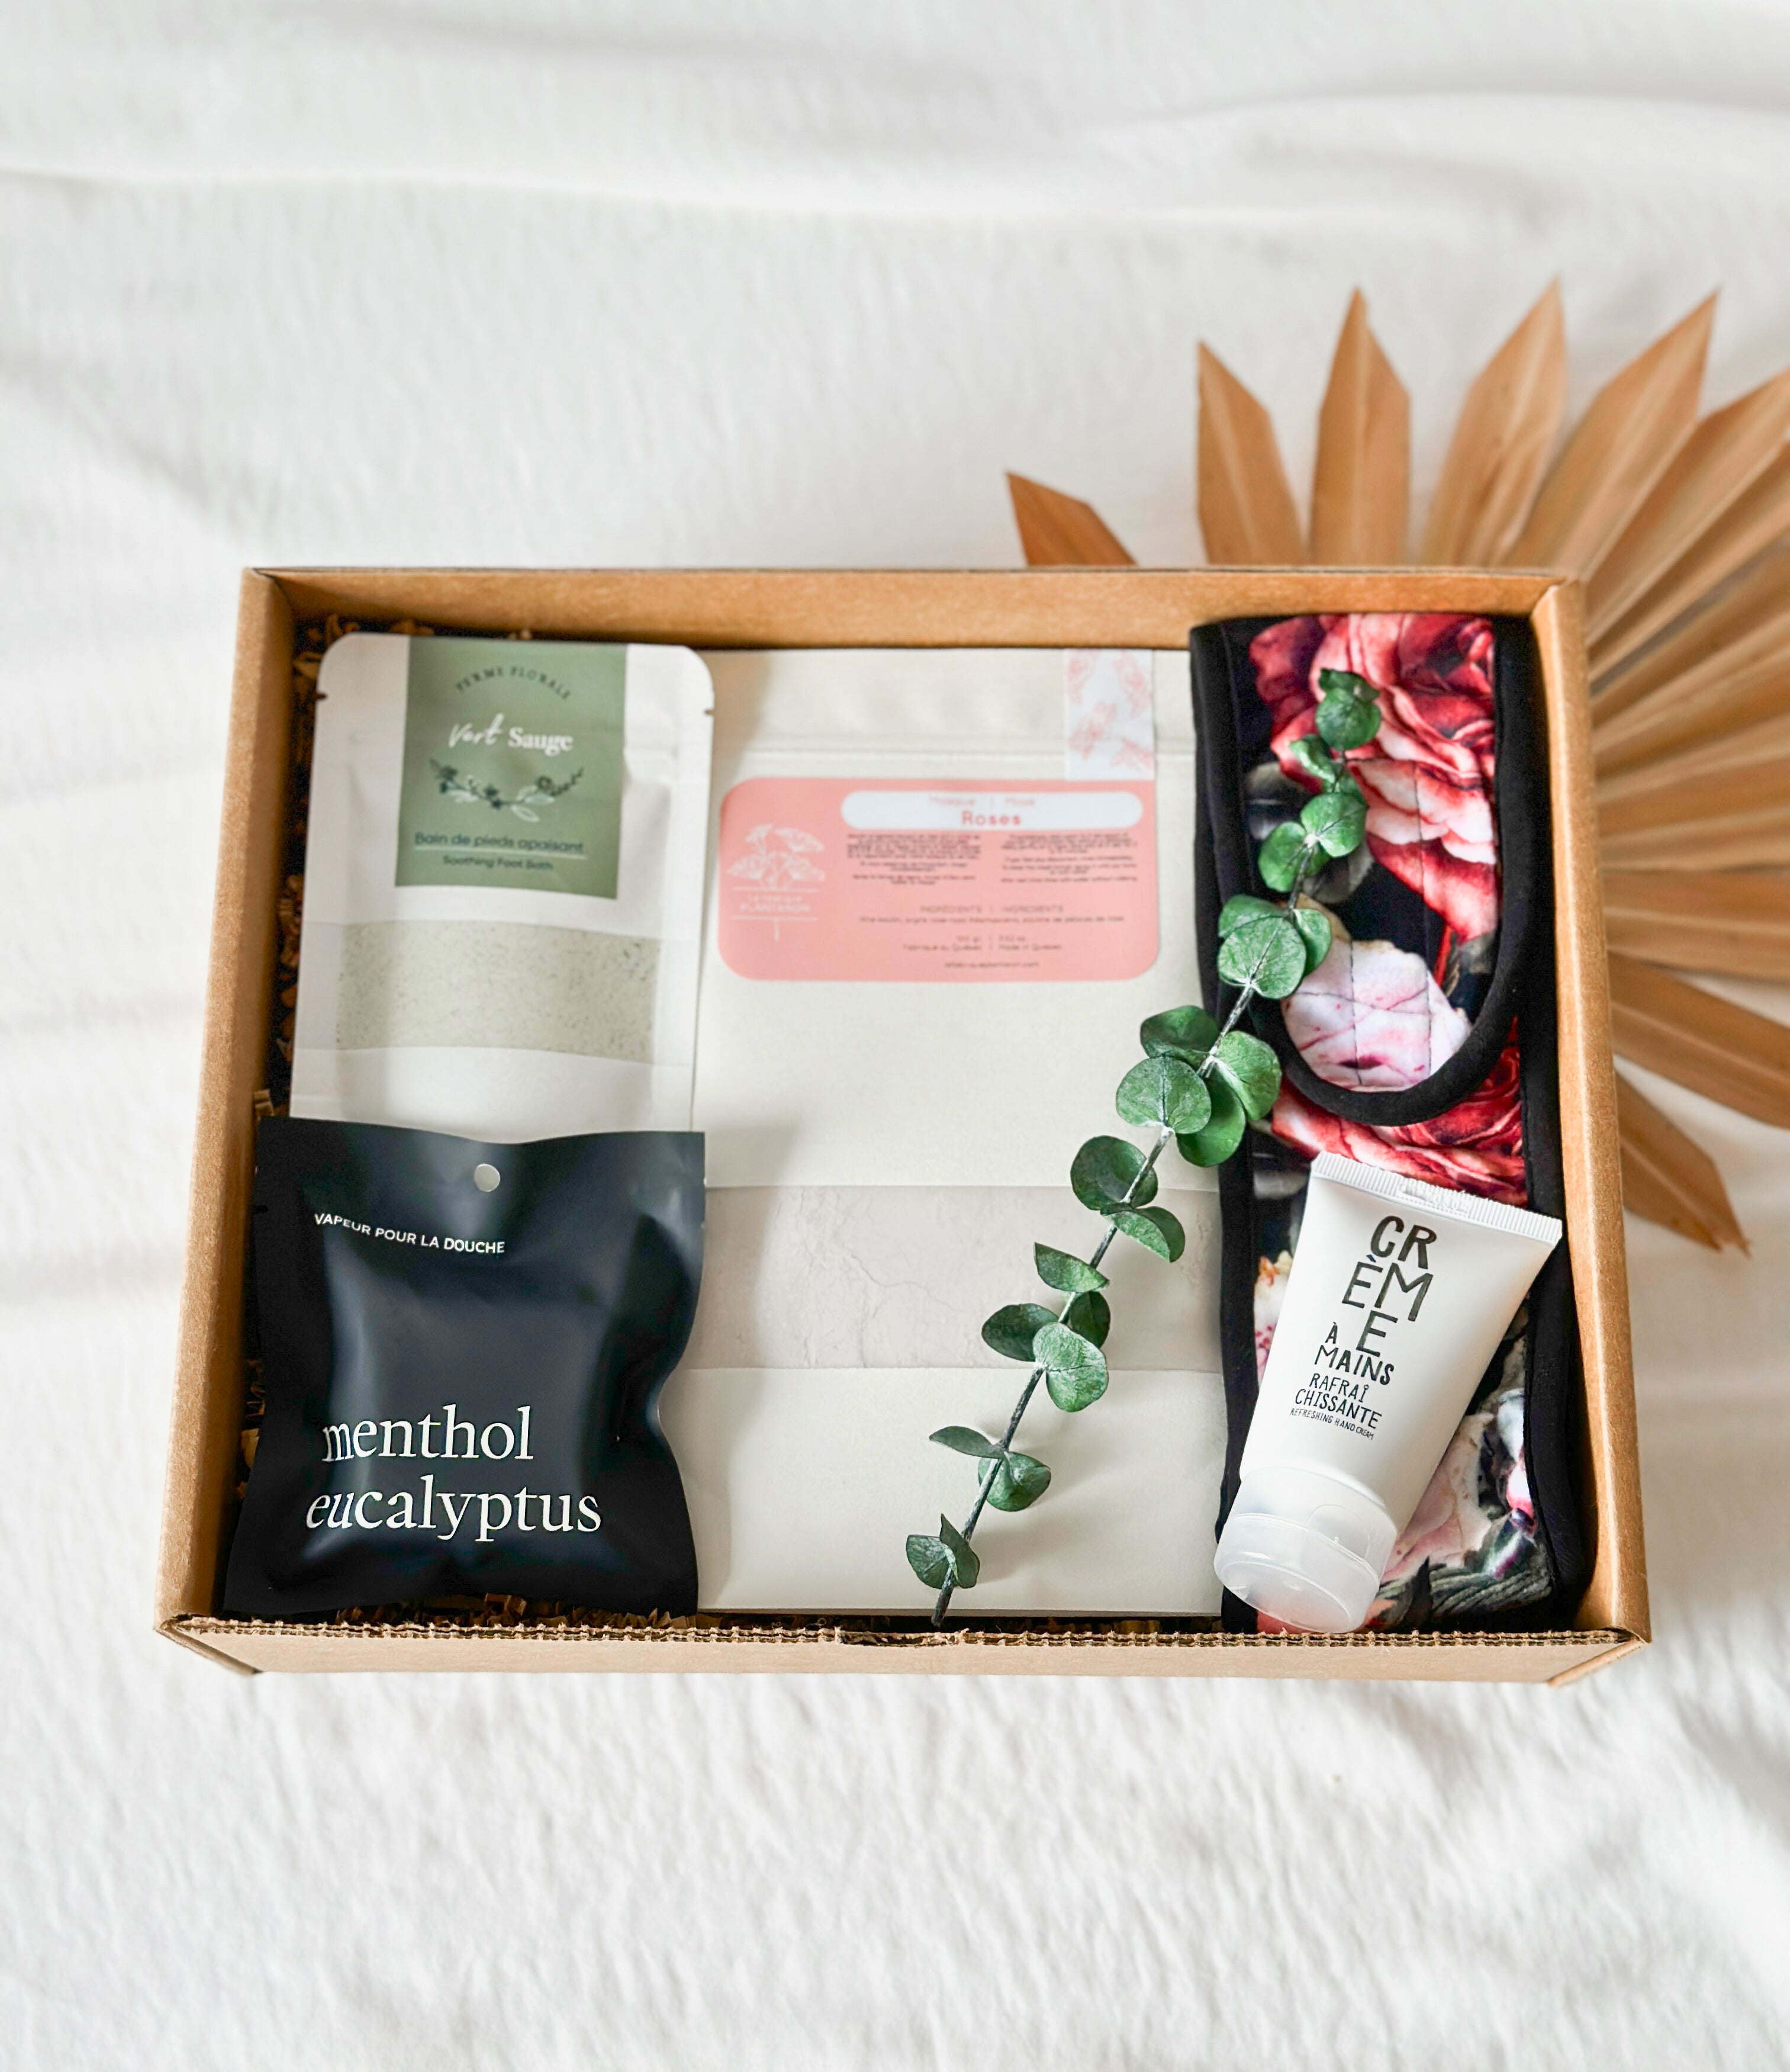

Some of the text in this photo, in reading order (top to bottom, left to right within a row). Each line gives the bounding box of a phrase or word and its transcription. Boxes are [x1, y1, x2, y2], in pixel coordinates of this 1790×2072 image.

[456, 667, 571, 700] FERME FLORALE
[508, 727, 573, 757] Sauge
[961, 810, 1021, 826] Roses
[415, 832, 584, 852] Bain de pieds apaisant
[443, 855, 553, 870] Soothing Foot Bath
[314, 1213, 505, 1254] VAPEUR POUR LA DOUCHE
[1325, 1322, 1338, 1344] À
[1314, 1344, 1395, 1385] MAINS
[1309, 1373, 1370, 1403] RAFRAÎ
[1290, 1407, 1374, 1440] REFRESHING HAND CREAM
[1295, 1388, 1382, 1430] CHISSANTE
[322, 1404, 534, 1463] menthol
[306, 1474, 602, 1542] eucalyptus
